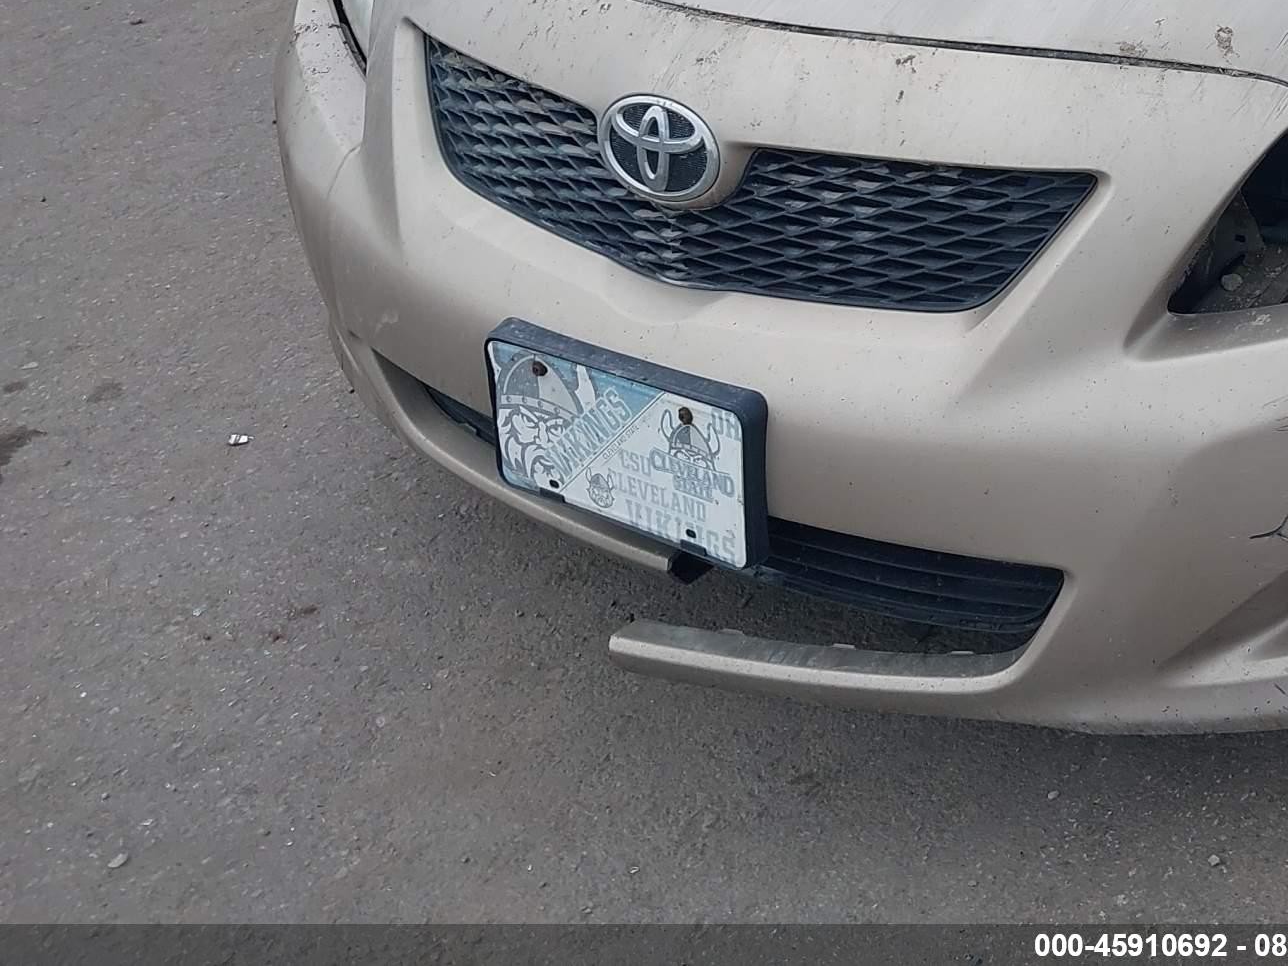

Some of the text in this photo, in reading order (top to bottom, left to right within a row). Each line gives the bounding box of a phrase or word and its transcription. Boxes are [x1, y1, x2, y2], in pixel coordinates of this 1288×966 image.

[543, 387, 633, 484] VIKINGS
[602, 434, 628, 460] CLEVELAND
[620, 450, 651, 477] CSU
[649, 447, 736, 498] CLEVELAND
[608, 468, 706, 522] CLEVELAND
[673, 474, 713, 502] STATE
